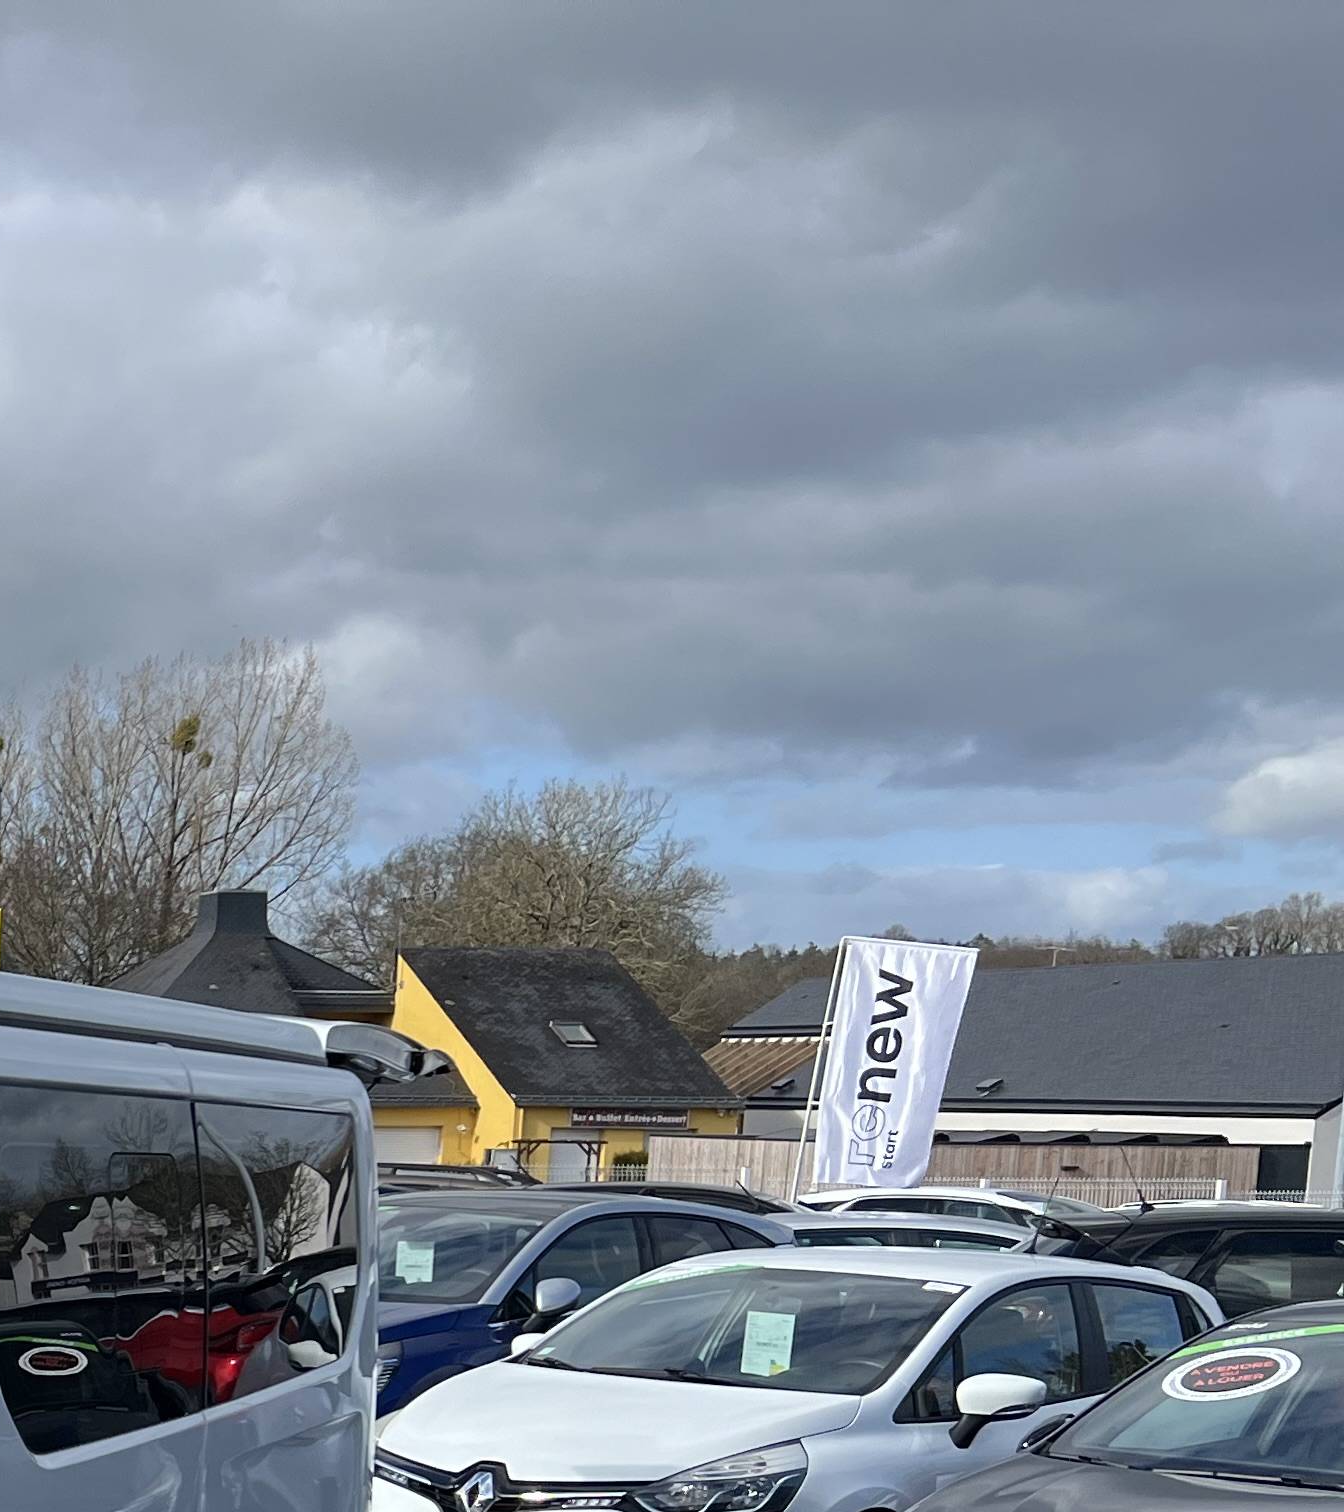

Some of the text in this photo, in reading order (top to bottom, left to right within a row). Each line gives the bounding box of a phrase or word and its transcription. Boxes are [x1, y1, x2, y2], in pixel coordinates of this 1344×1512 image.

[848, 967, 914, 1168] renew
[881, 1129, 899, 1169] start
[1204, 1360, 1276, 1374] VENDRE
